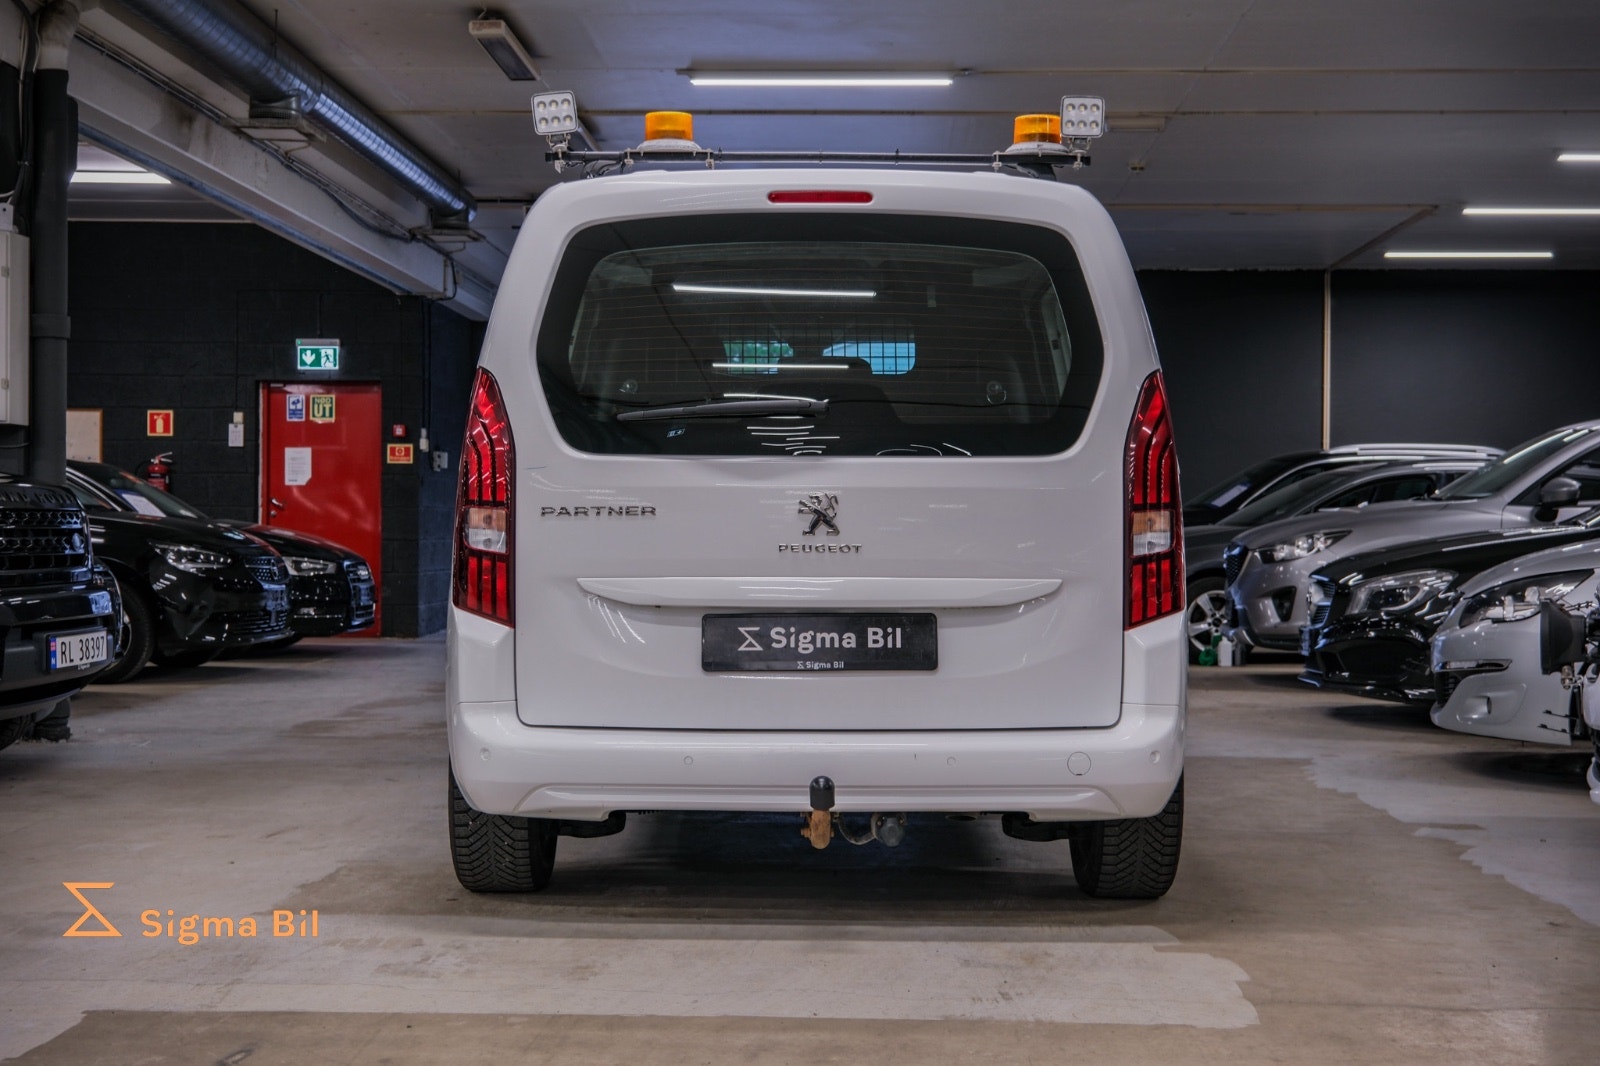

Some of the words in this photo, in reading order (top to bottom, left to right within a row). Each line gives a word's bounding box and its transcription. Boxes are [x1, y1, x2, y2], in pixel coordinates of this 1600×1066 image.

[314, 403, 331, 418] UT
[540, 506, 657, 517] PARTNER
[778, 543, 862, 553] PEUGEOT
[769, 626, 857, 654] Sigma
[867, 627, 902, 649] Bil
[60, 641, 74, 665] RL
[79, 636, 104, 662] 38397
[805, 661, 831, 670] Sigma
[833, 661, 844, 669] Bil
